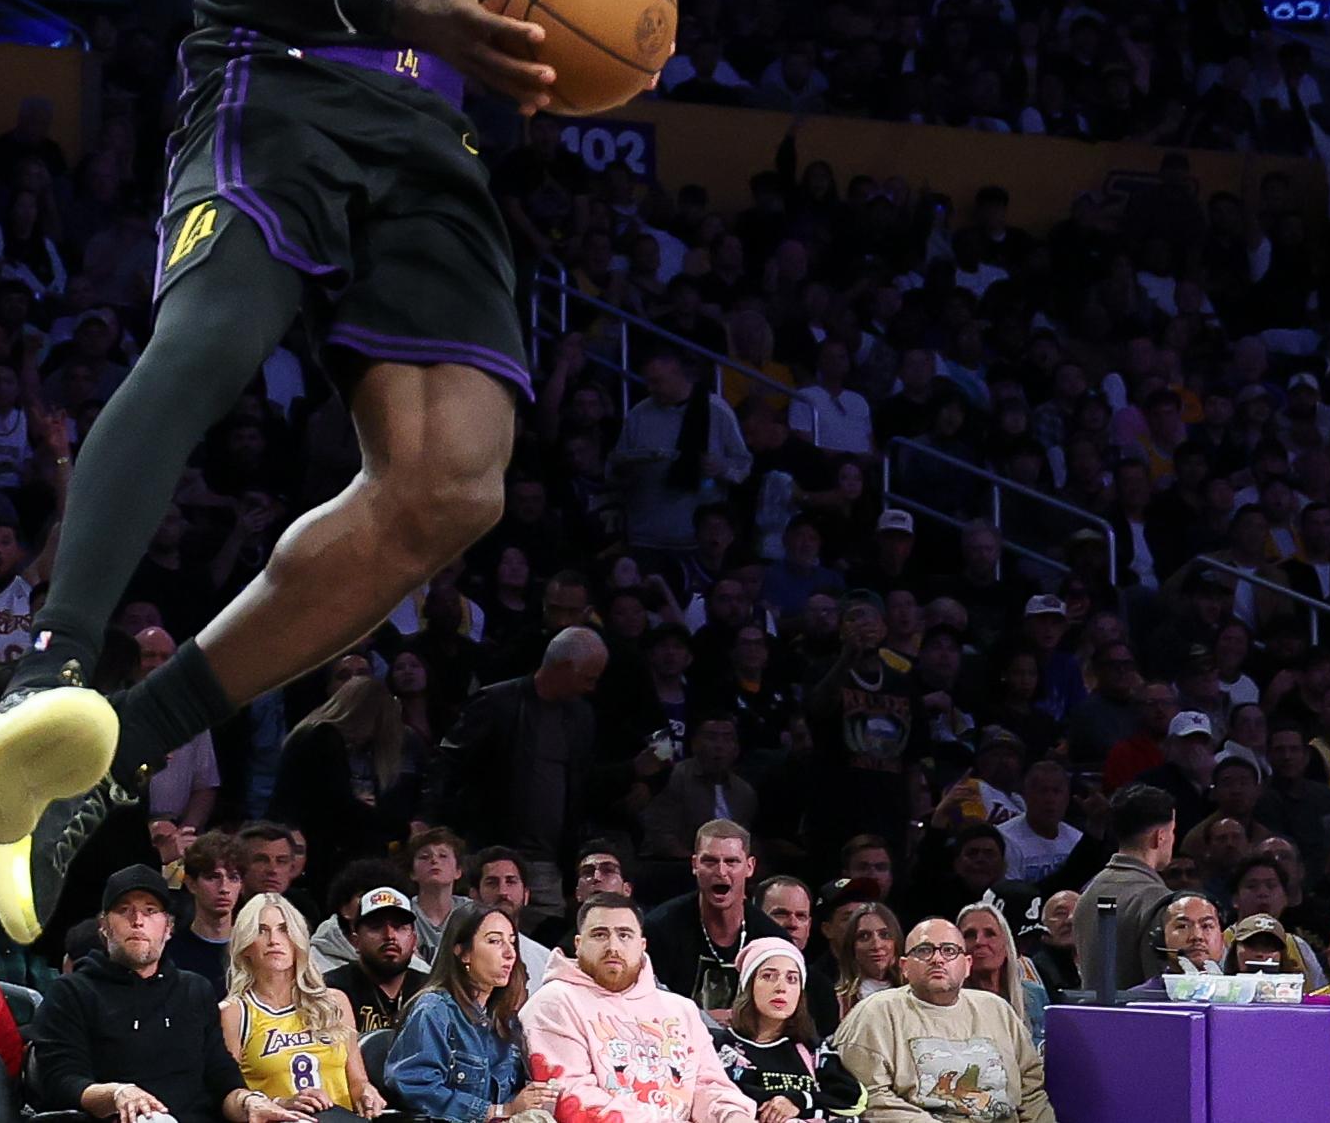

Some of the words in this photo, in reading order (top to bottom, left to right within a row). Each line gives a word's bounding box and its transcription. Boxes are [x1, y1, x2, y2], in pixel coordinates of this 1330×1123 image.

[560, 125, 646, 175] 102
[259, 1028, 333, 1057] LAKES
[290, 1052, 319, 1095] 8
